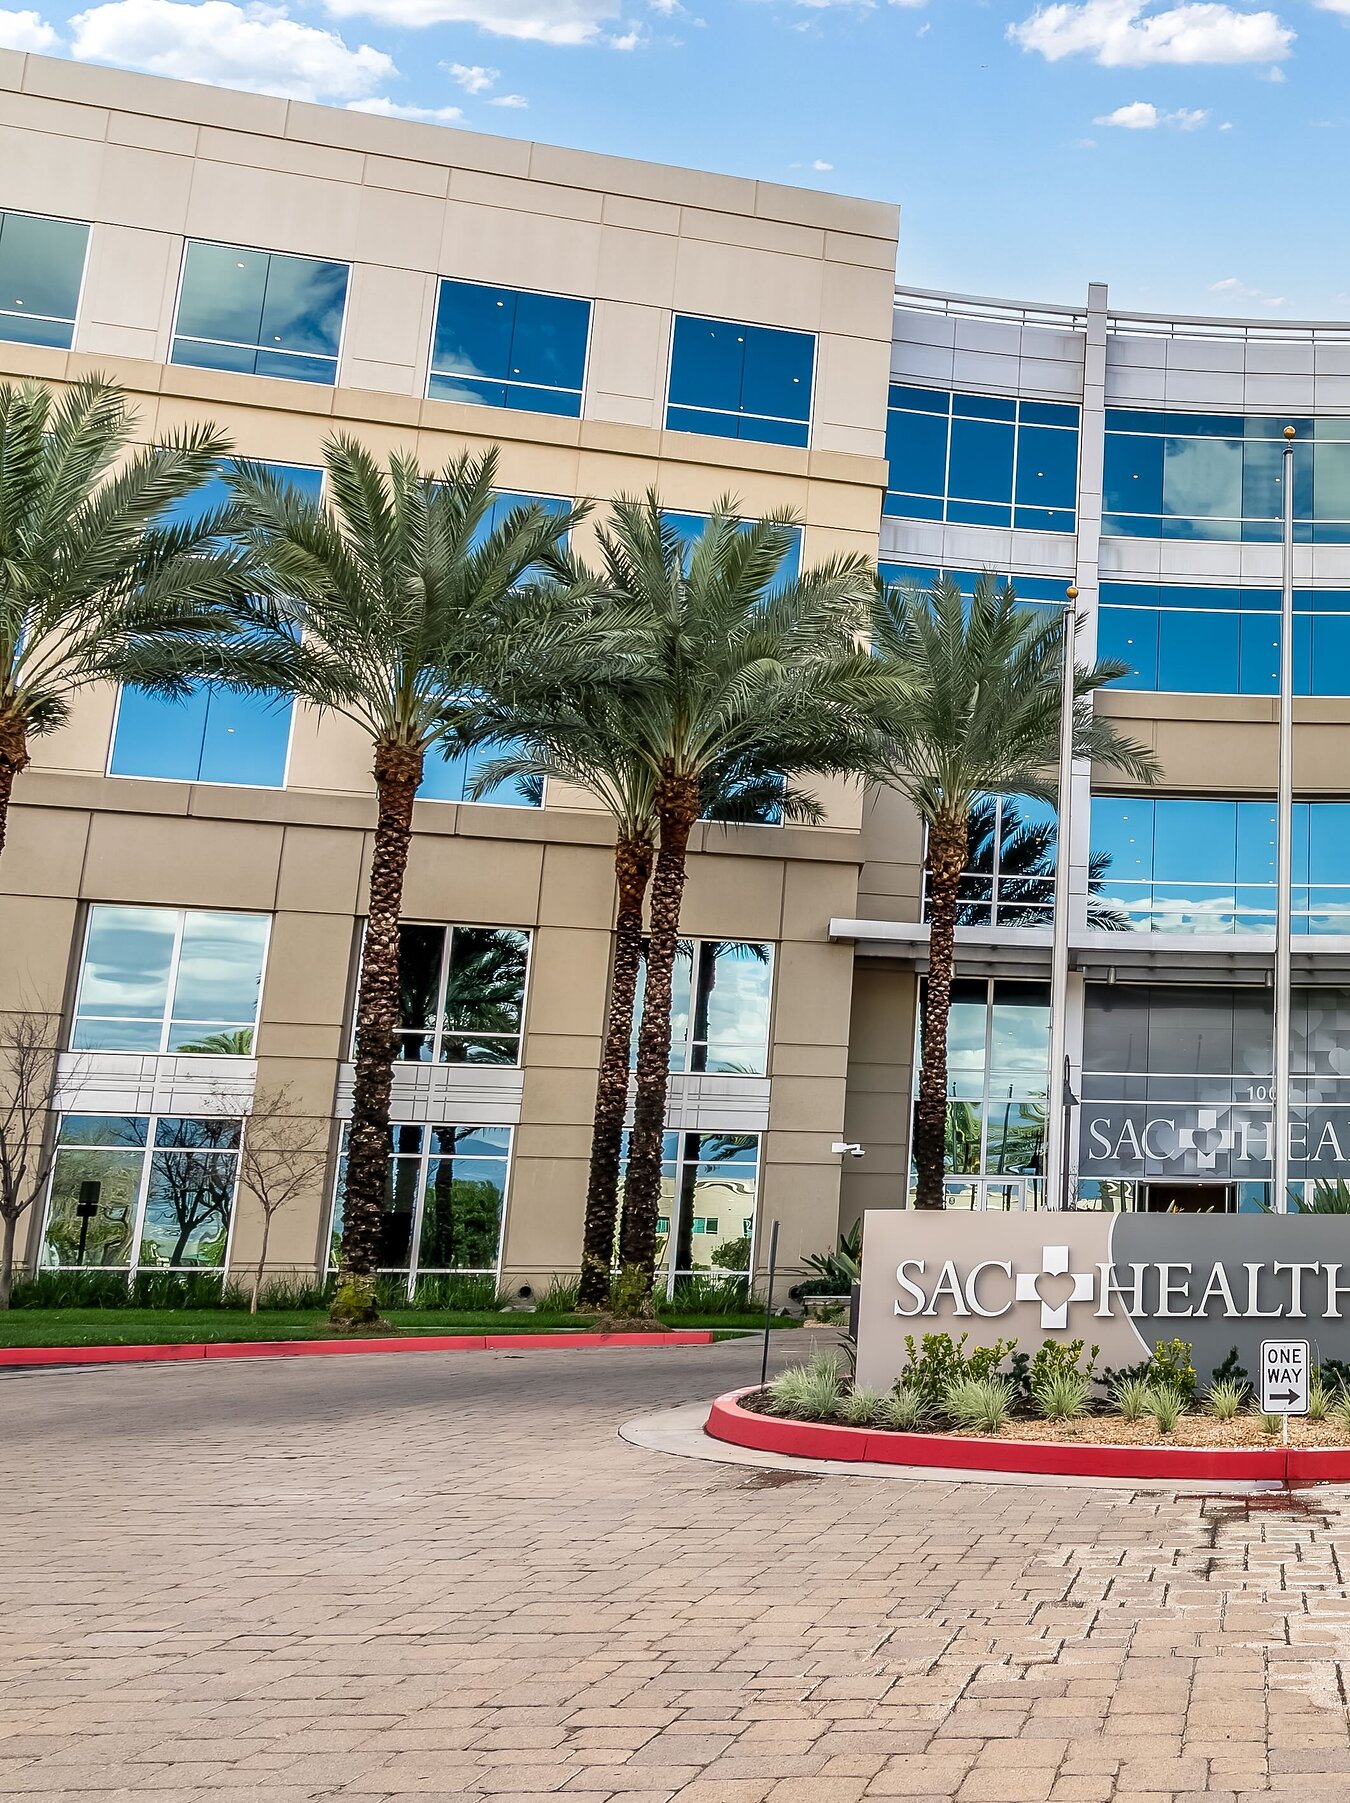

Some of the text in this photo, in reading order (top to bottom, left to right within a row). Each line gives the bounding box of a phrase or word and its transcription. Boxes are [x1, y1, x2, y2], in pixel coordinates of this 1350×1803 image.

[1088, 1118, 1176, 1161] SAC
[894, 1259, 1013, 1317] SAC
[1268, 1349, 1301, 1363] ONE
[1268, 1368, 1302, 1383] WAY
